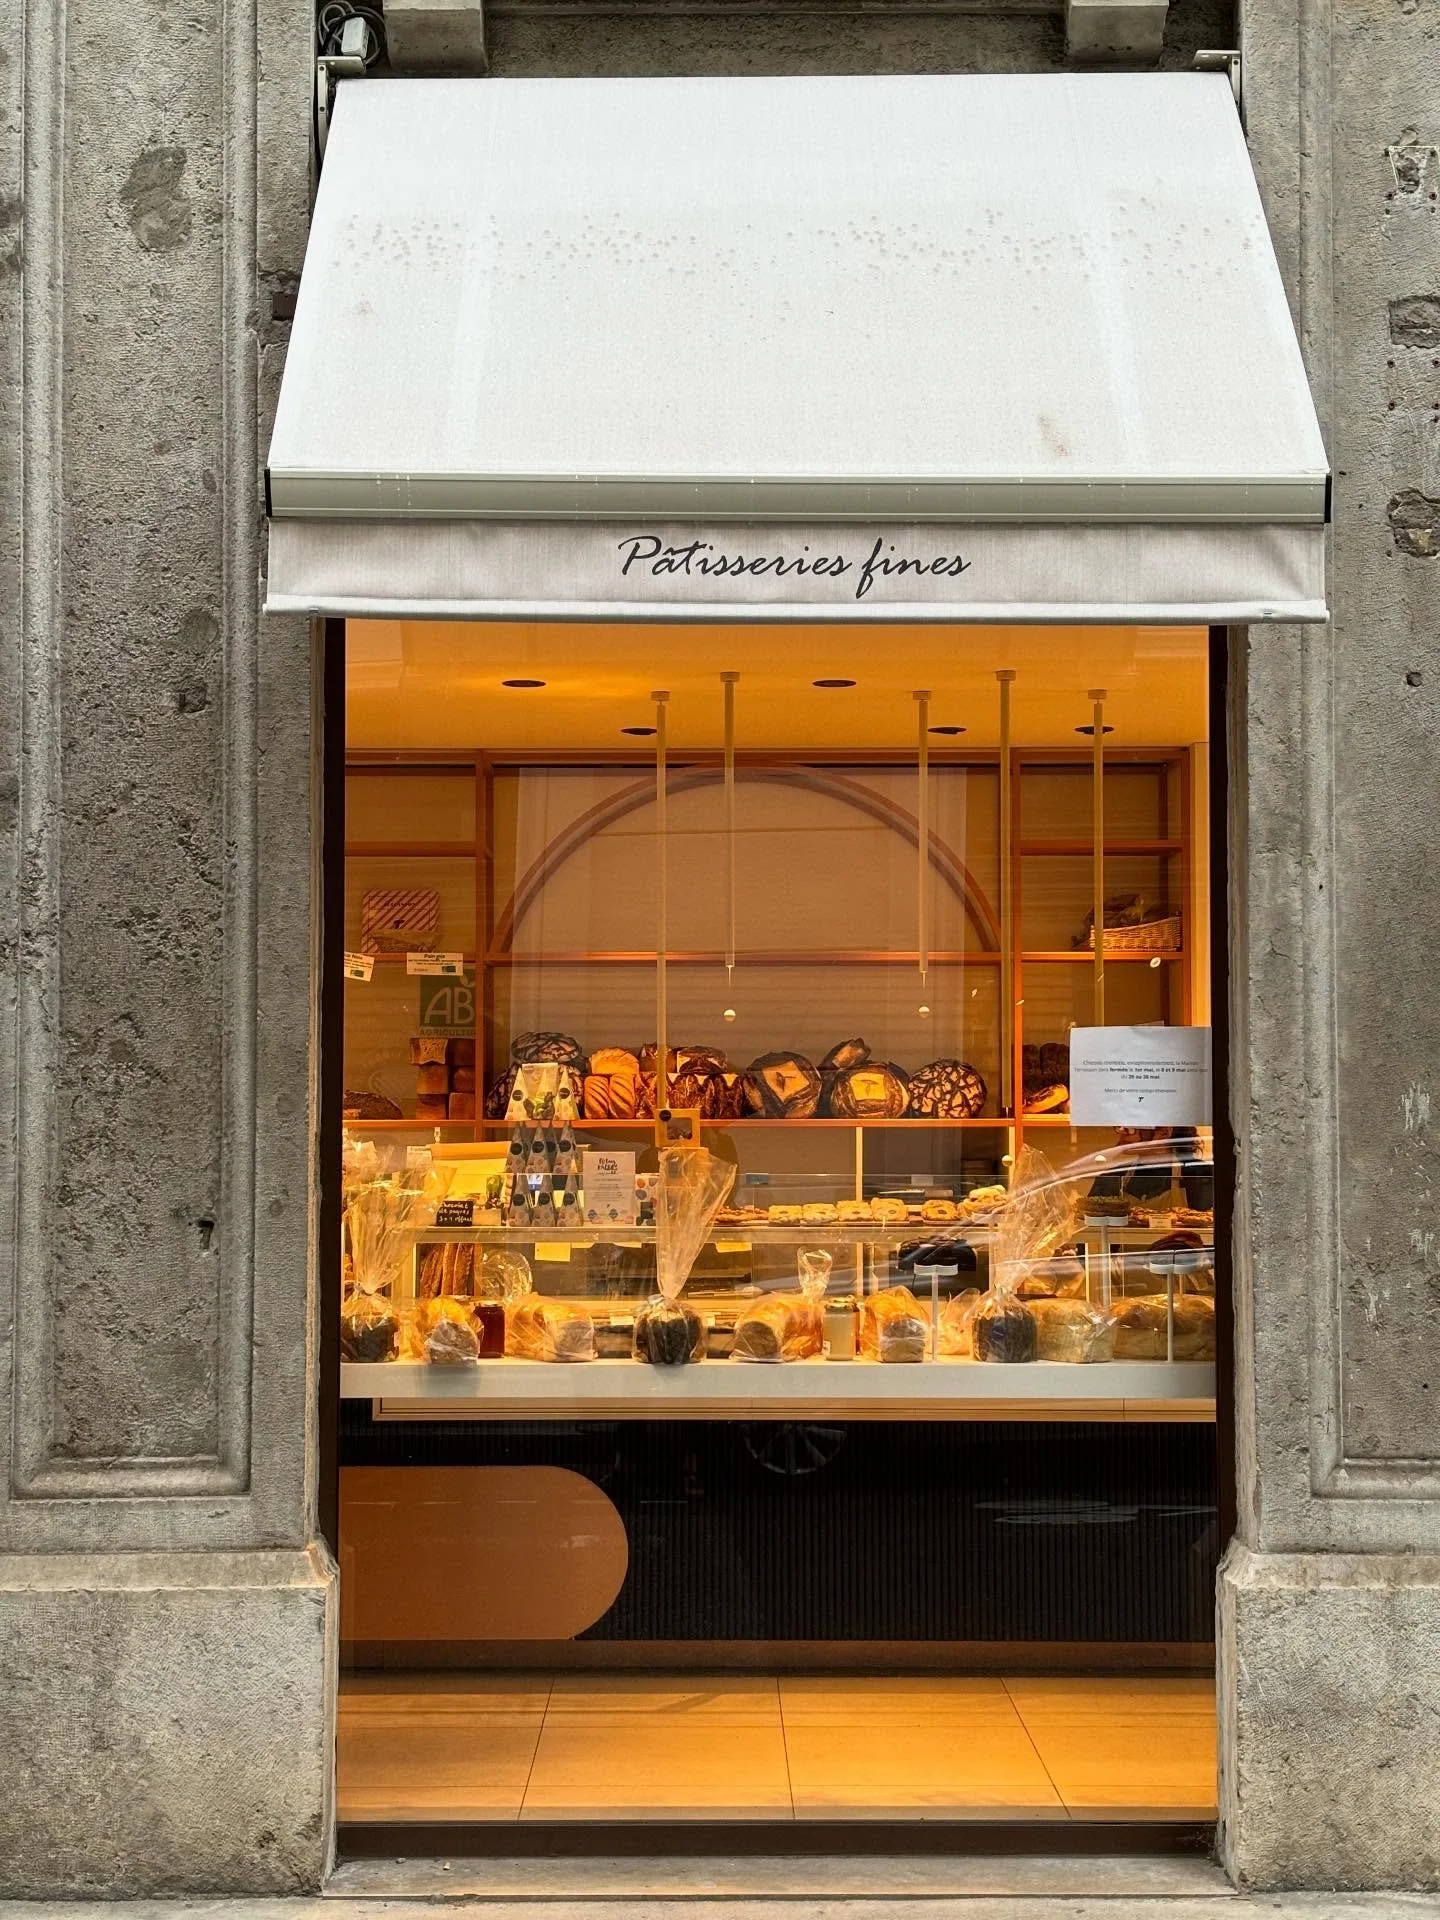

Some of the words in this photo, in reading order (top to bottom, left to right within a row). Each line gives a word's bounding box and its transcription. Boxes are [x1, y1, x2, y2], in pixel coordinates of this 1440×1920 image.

[618, 535, 852, 576] Pâtisseries
[856, 537, 971, 599] fines
[423, 987, 476, 1025] AB
